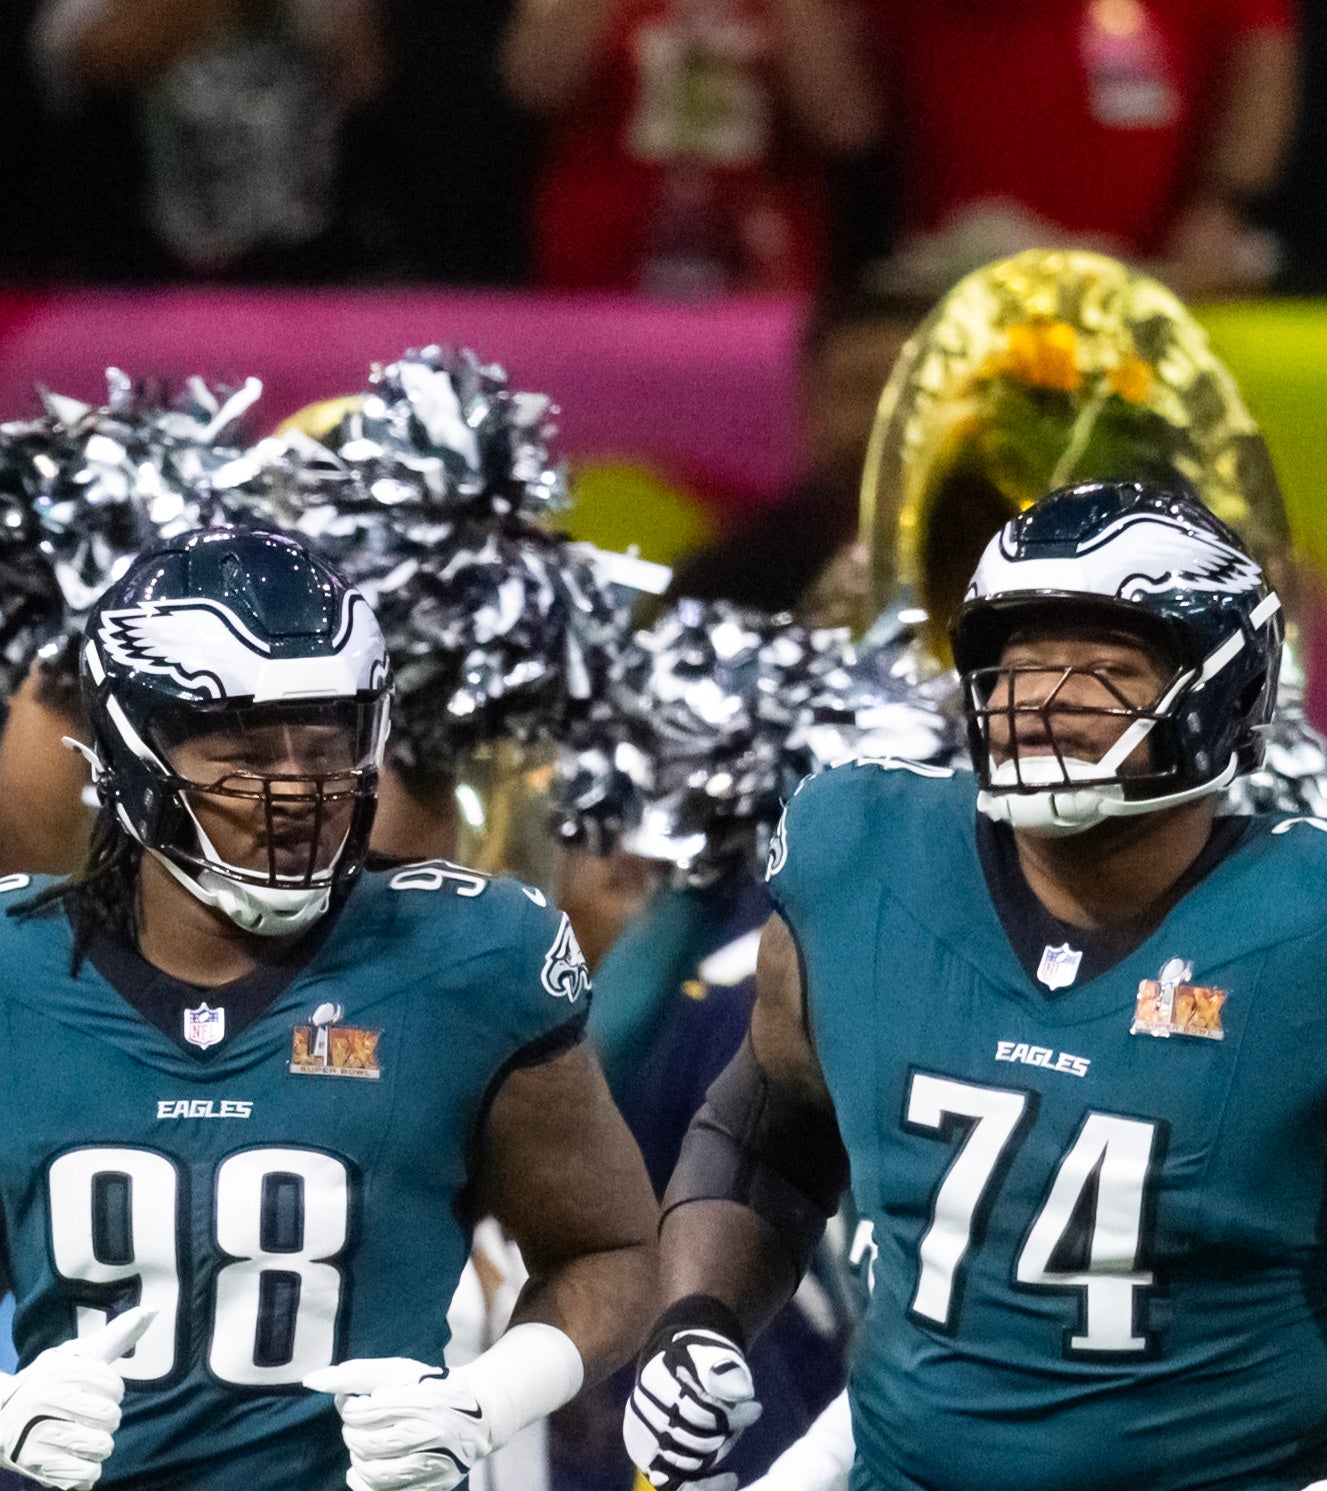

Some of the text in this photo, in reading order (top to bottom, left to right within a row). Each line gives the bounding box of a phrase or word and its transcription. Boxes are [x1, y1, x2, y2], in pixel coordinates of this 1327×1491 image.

[156, 1099, 254, 1119] EAGLES
[995, 1040, 1091, 1077] EAGLES
[48, 1146, 349, 1386] 98
[906, 1072, 1156, 1351] 74
